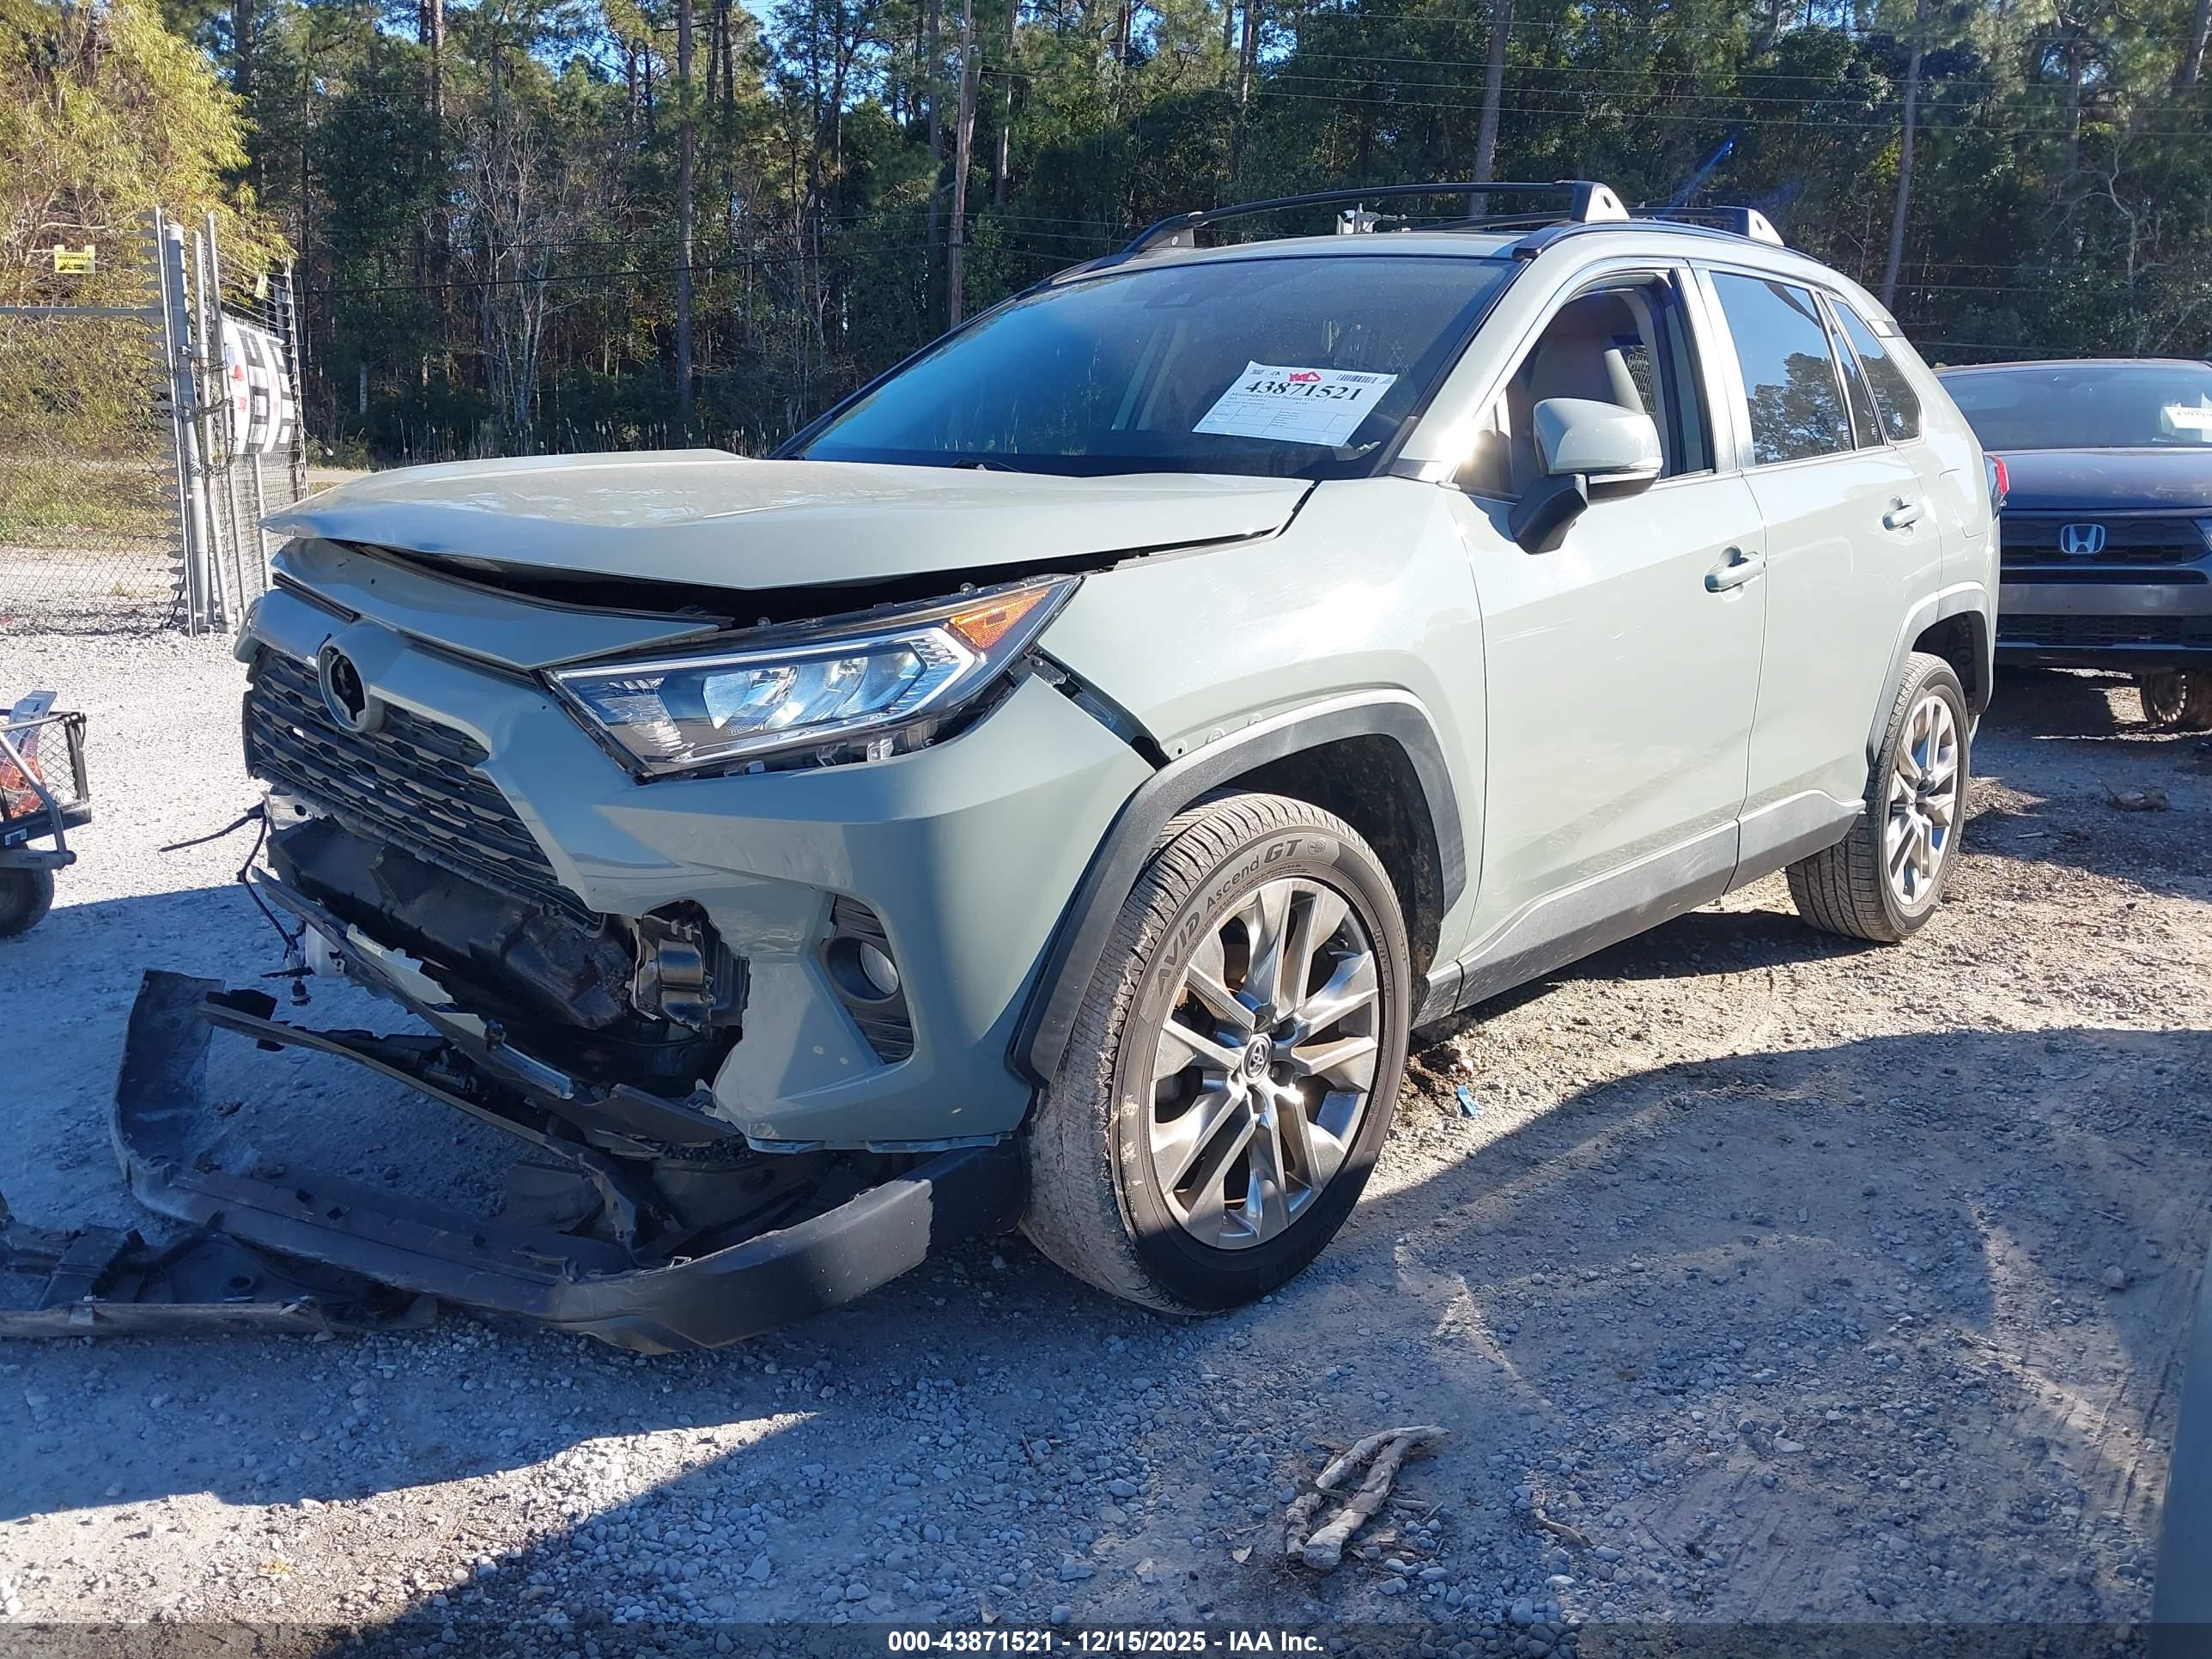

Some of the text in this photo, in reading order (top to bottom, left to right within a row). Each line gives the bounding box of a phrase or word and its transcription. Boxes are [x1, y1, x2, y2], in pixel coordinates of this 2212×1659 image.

[1245, 380, 1363, 401] 43871521
[1158, 912, 1201, 995] AVID
[1206, 855, 1260, 914] Ascend
[1264, 839, 1304, 864] GT
